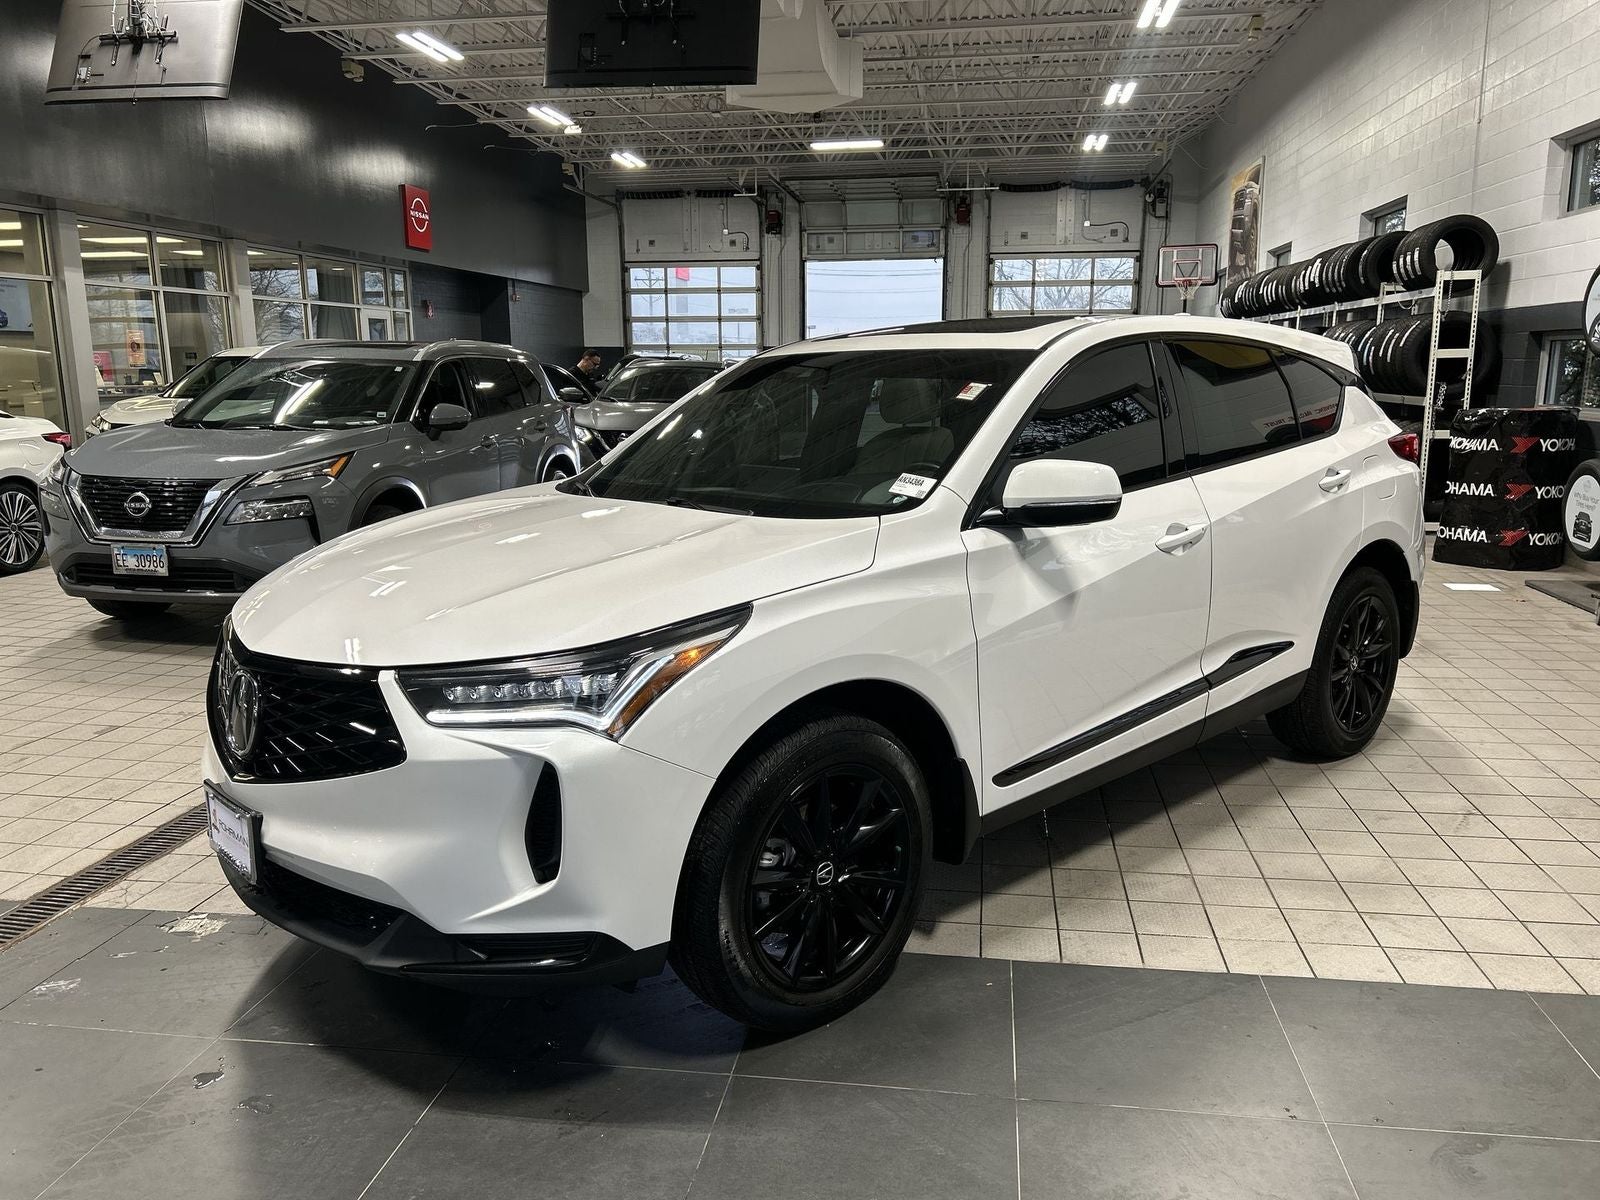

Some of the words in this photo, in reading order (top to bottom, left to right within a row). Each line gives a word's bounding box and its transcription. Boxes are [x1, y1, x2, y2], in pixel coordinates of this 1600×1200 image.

[410, 210, 429, 220] NISSAN
[115, 553, 128, 568] EE
[134, 553, 165, 569] 30986
